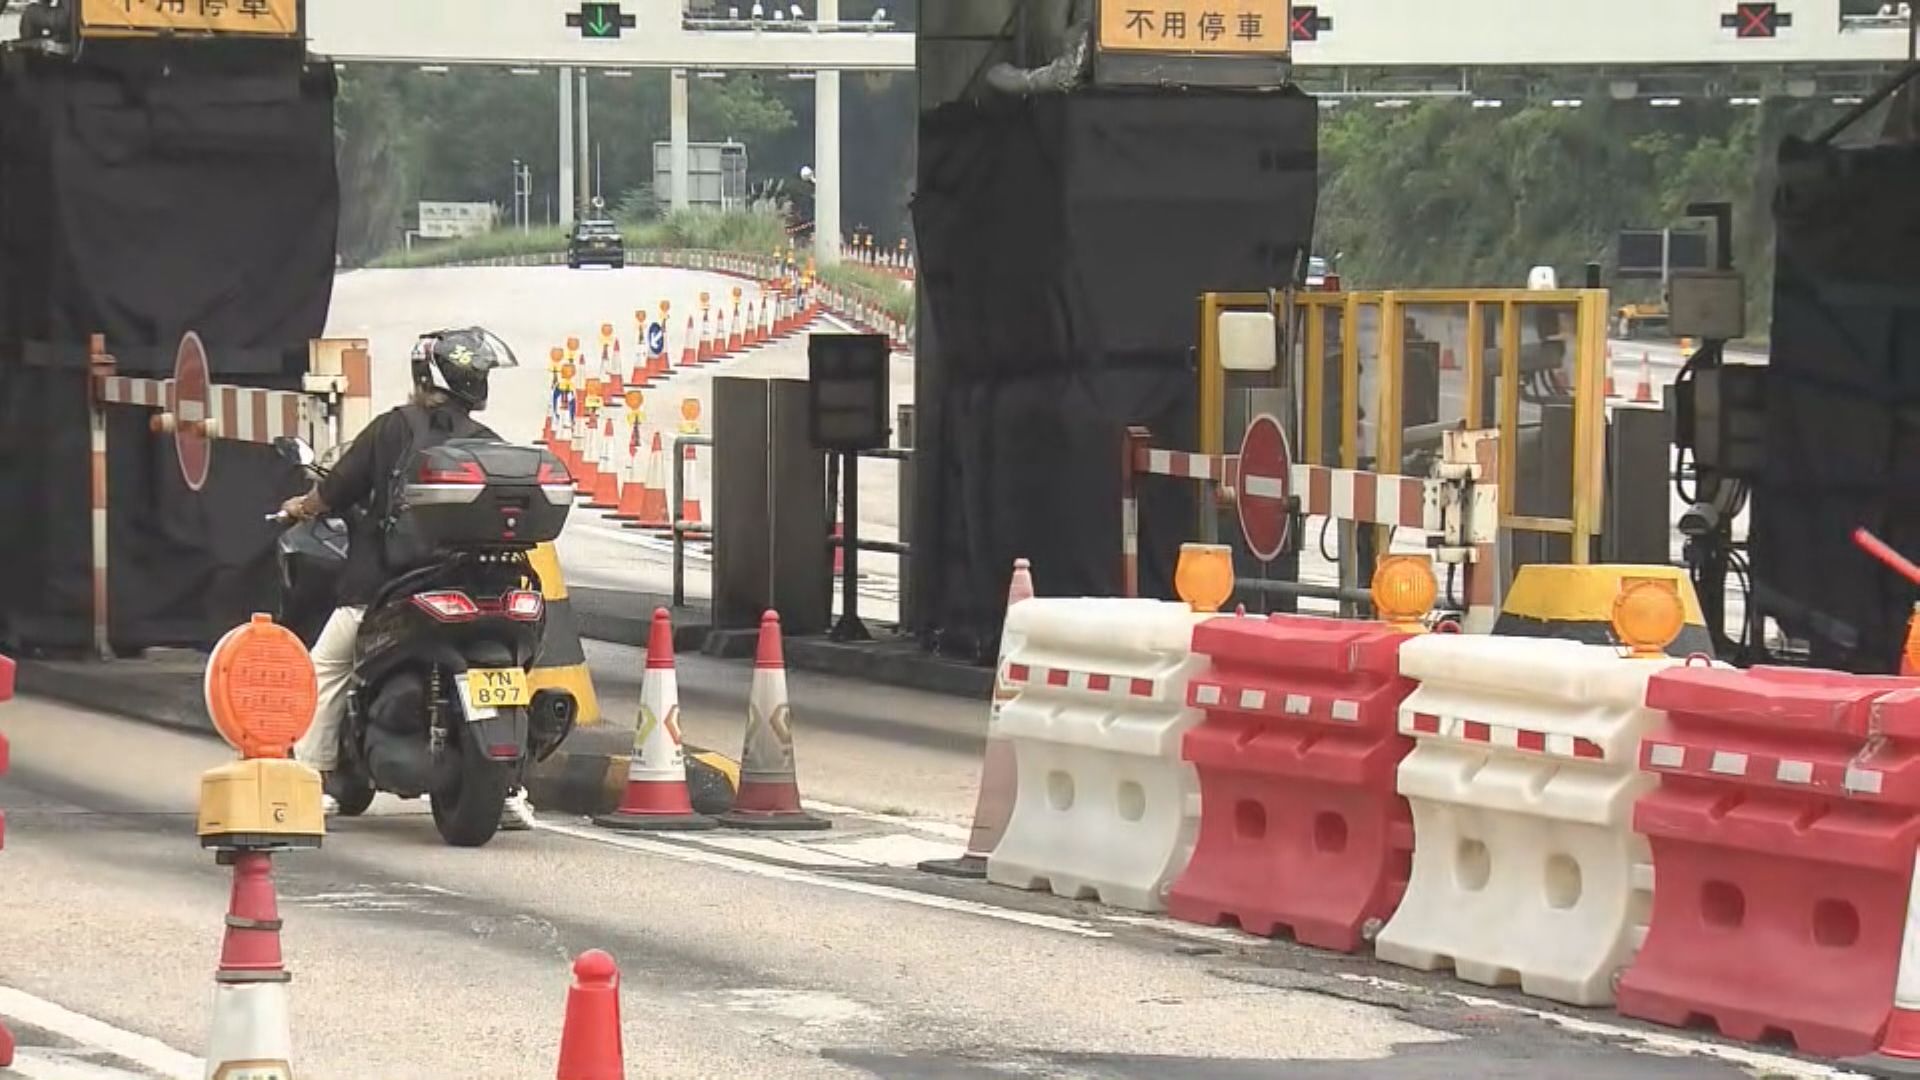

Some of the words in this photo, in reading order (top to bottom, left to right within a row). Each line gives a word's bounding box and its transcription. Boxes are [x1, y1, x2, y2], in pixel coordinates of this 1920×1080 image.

[1125, 9, 1263, 41] 不用停車
[483, 672, 512, 686] YN
[479, 688, 520, 703] 897
